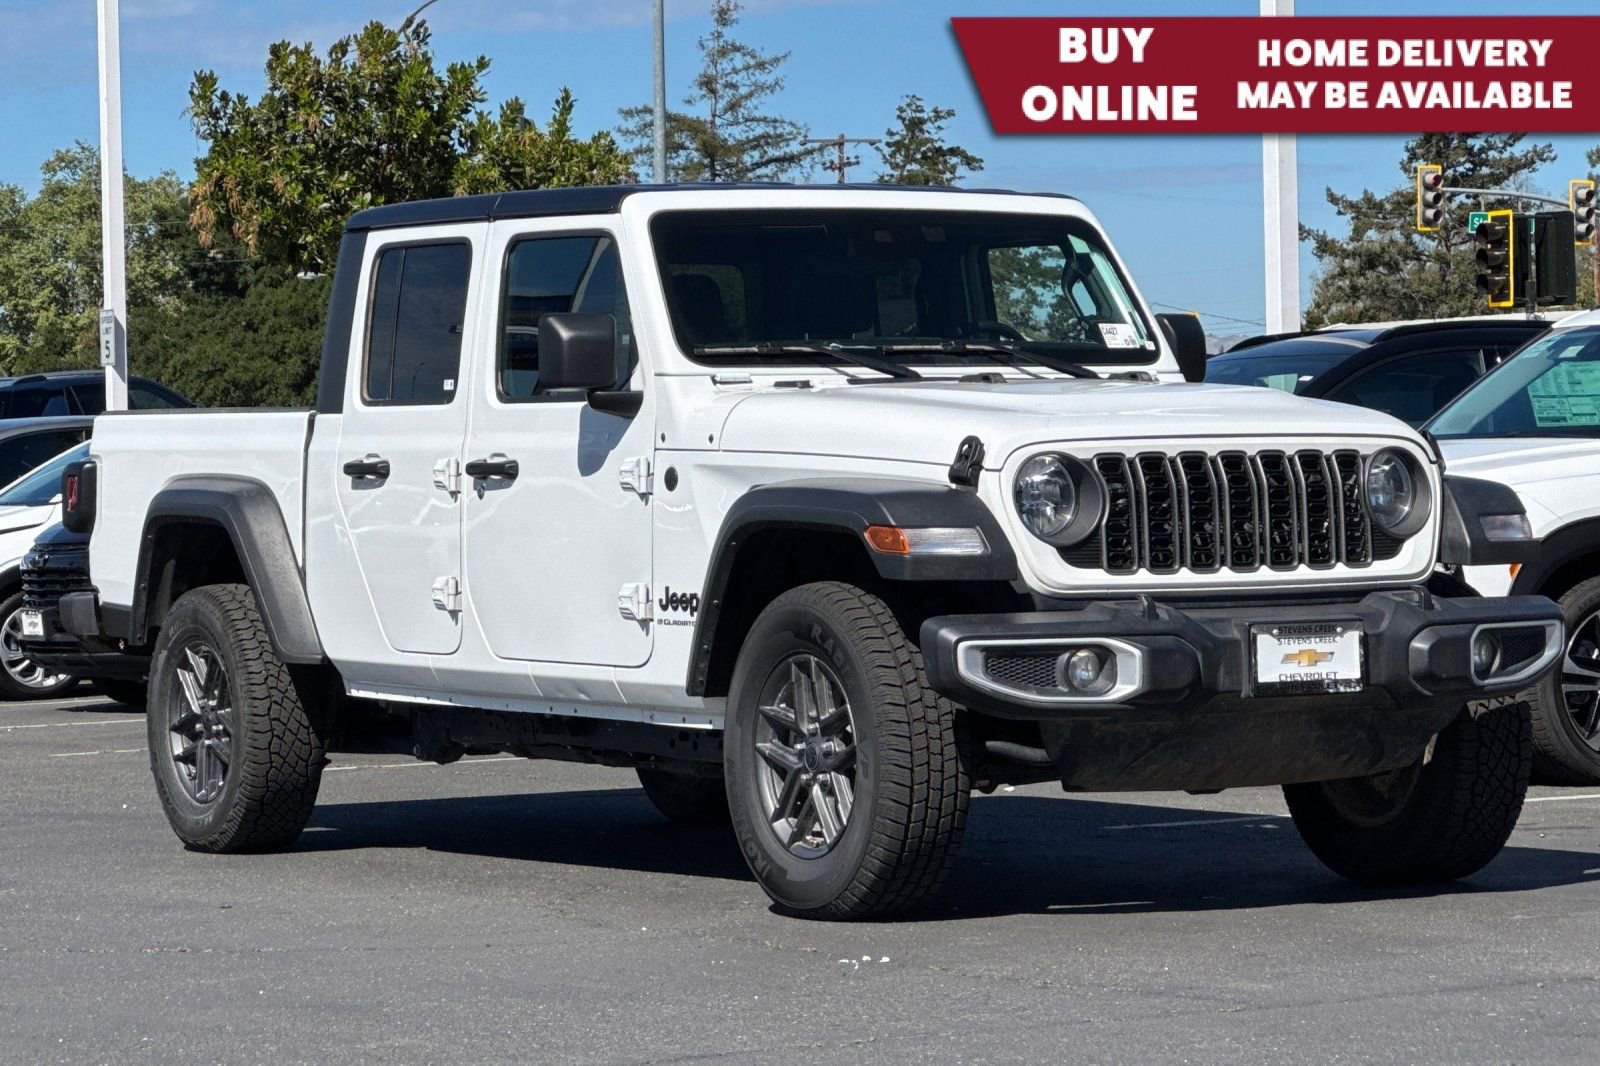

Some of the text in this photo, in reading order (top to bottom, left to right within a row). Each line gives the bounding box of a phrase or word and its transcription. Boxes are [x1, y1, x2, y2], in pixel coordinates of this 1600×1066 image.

[105, 340, 111, 359] 5
[658, 585, 700, 617] Jeep
[1278, 624, 1337, 634] STEVENS CREEK
[1277, 635, 1338, 646] STEVENS CREEK
[1278, 671, 1338, 682] CHEVROLET
